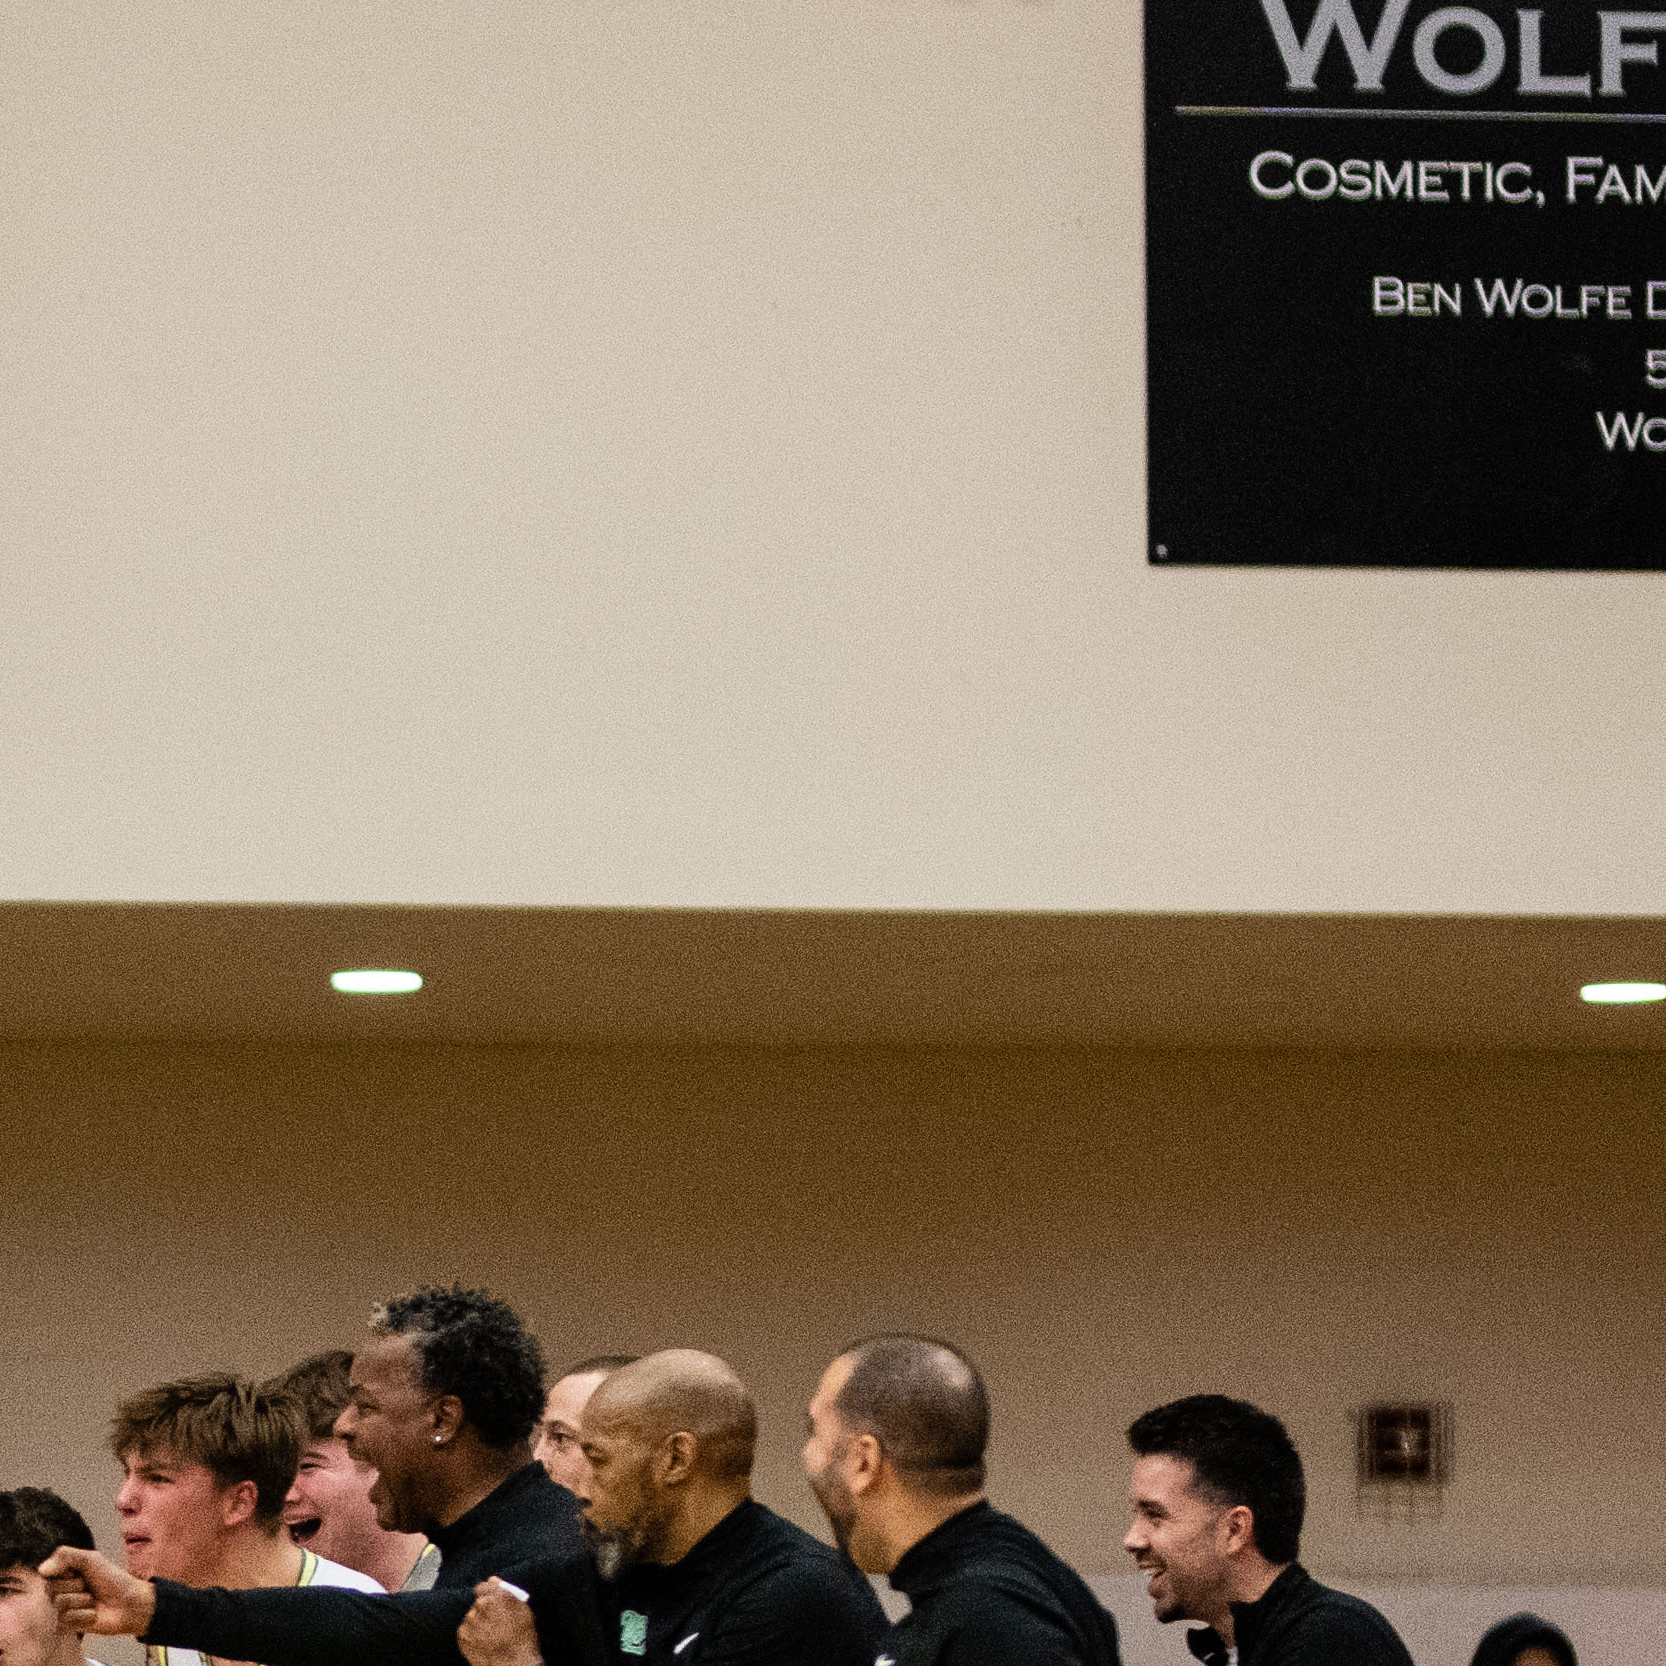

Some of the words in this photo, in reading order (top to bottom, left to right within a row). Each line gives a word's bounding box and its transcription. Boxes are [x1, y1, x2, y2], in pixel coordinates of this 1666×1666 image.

[1249, 149, 1545, 208] COSMETIC,
[1373, 275, 1462, 317] BEN
[1473, 277, 1632, 319] WOLFE
